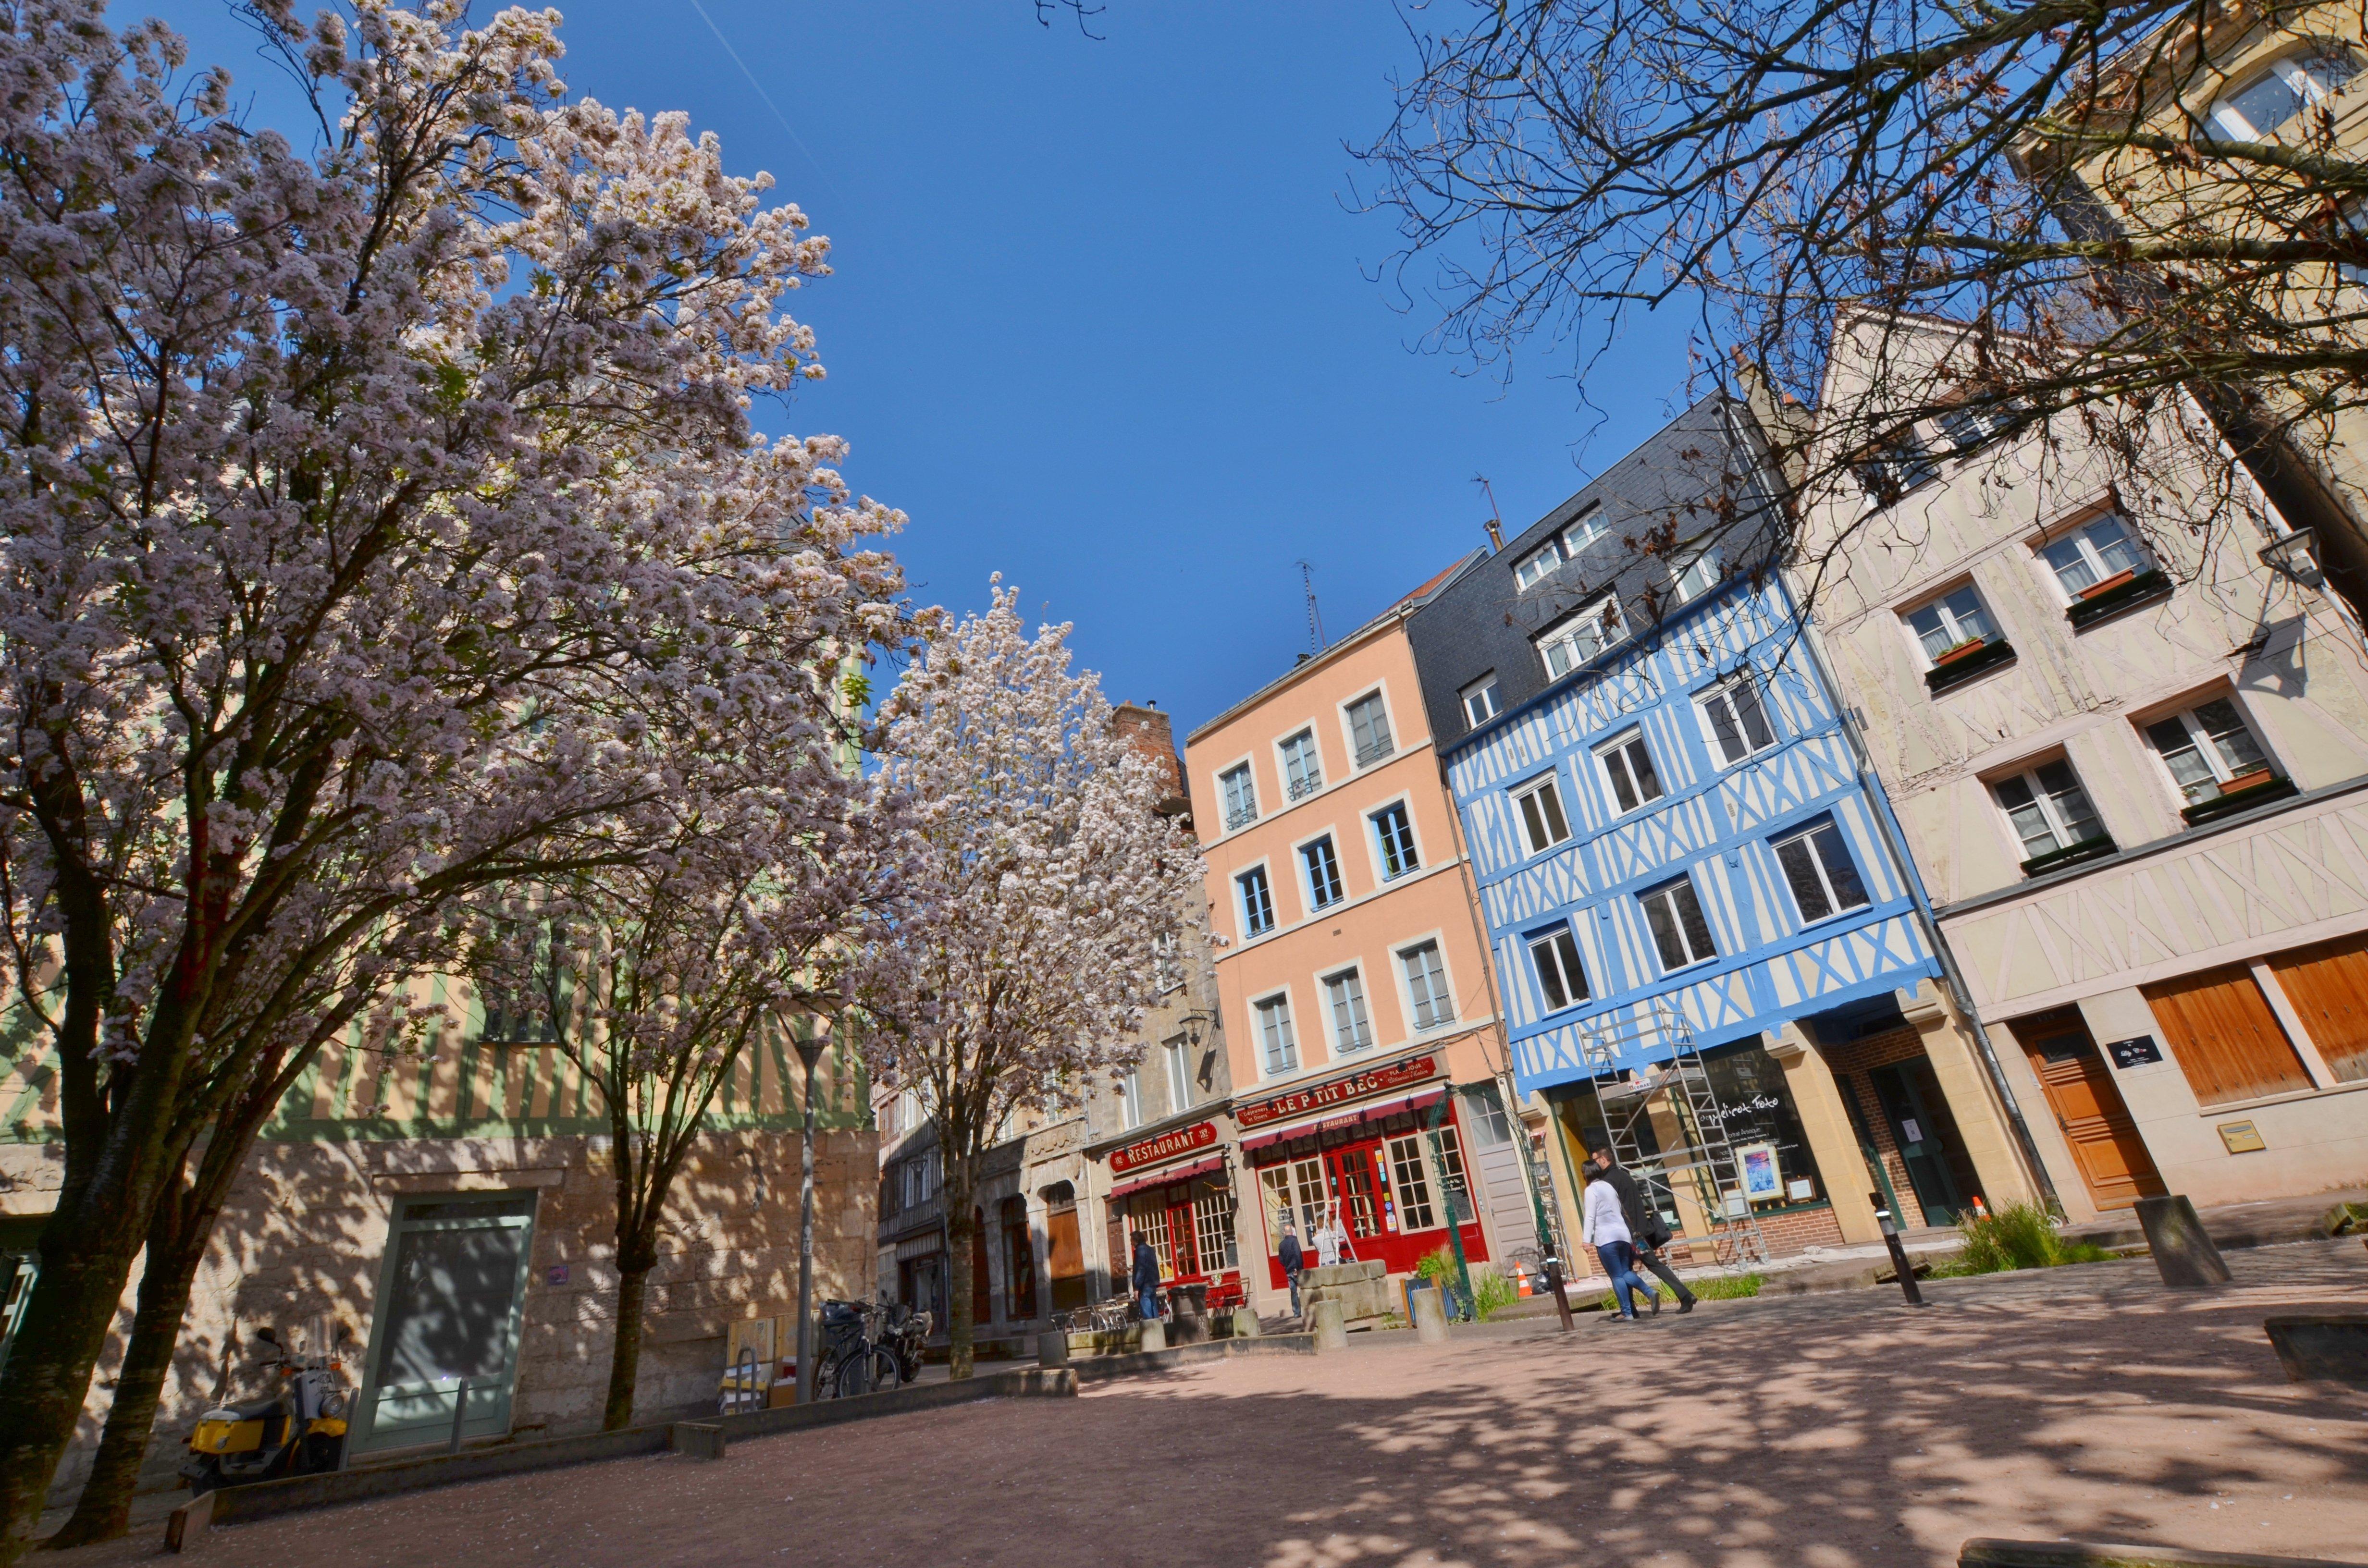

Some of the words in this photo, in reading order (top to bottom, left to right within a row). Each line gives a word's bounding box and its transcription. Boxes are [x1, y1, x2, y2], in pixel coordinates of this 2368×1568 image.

[1276, 1098, 1296, 1114] LE
[1344, 1076, 1378, 1096] BEC
[1699, 1102, 1752, 1127] oquelicot
[1751, 1094, 1778, 1109] Foto
[1127, 1131, 1195, 1164] RESTAURANT
[1199, 1128, 1209, 1139] 182
[1115, 1155, 1123, 1165] 182
